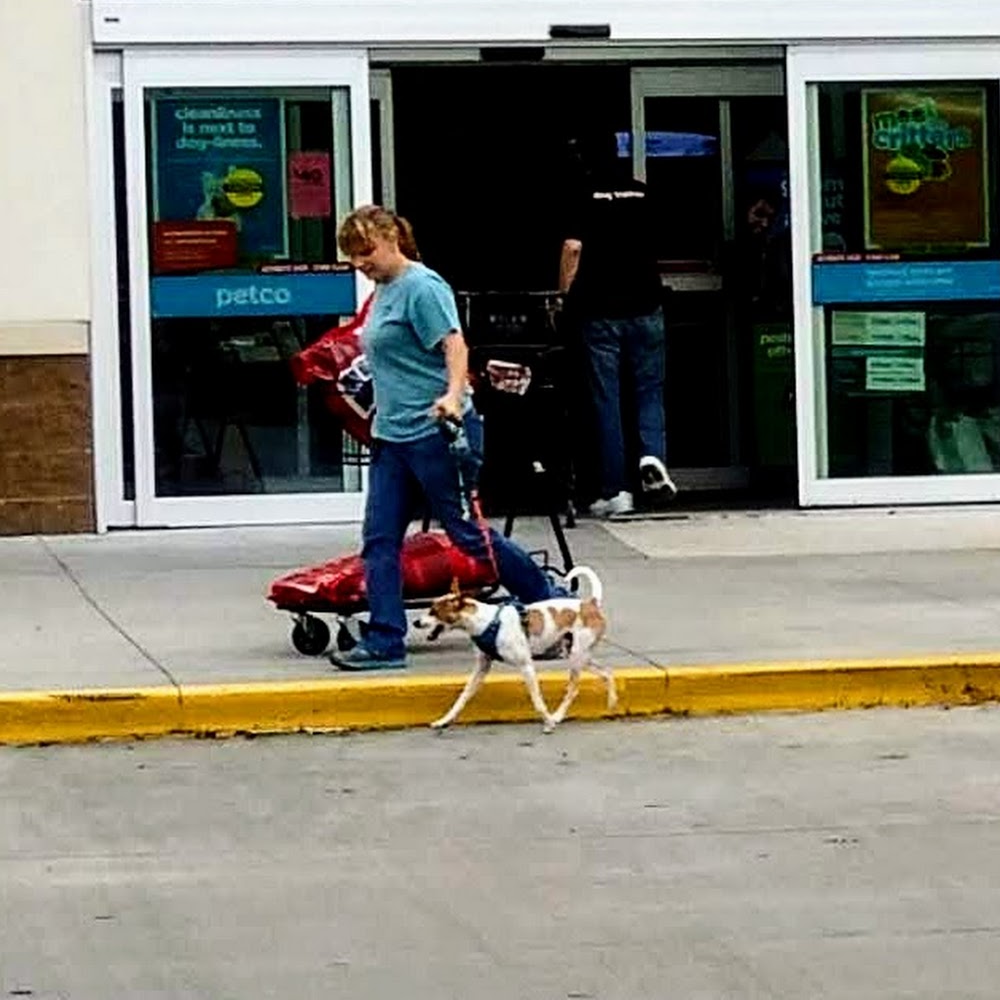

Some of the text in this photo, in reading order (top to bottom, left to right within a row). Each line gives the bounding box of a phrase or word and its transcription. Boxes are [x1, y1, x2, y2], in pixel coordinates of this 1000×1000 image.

[199, 122, 235, 134] next
[238, 121, 256, 134] to
[215, 285, 292, 308] petco
